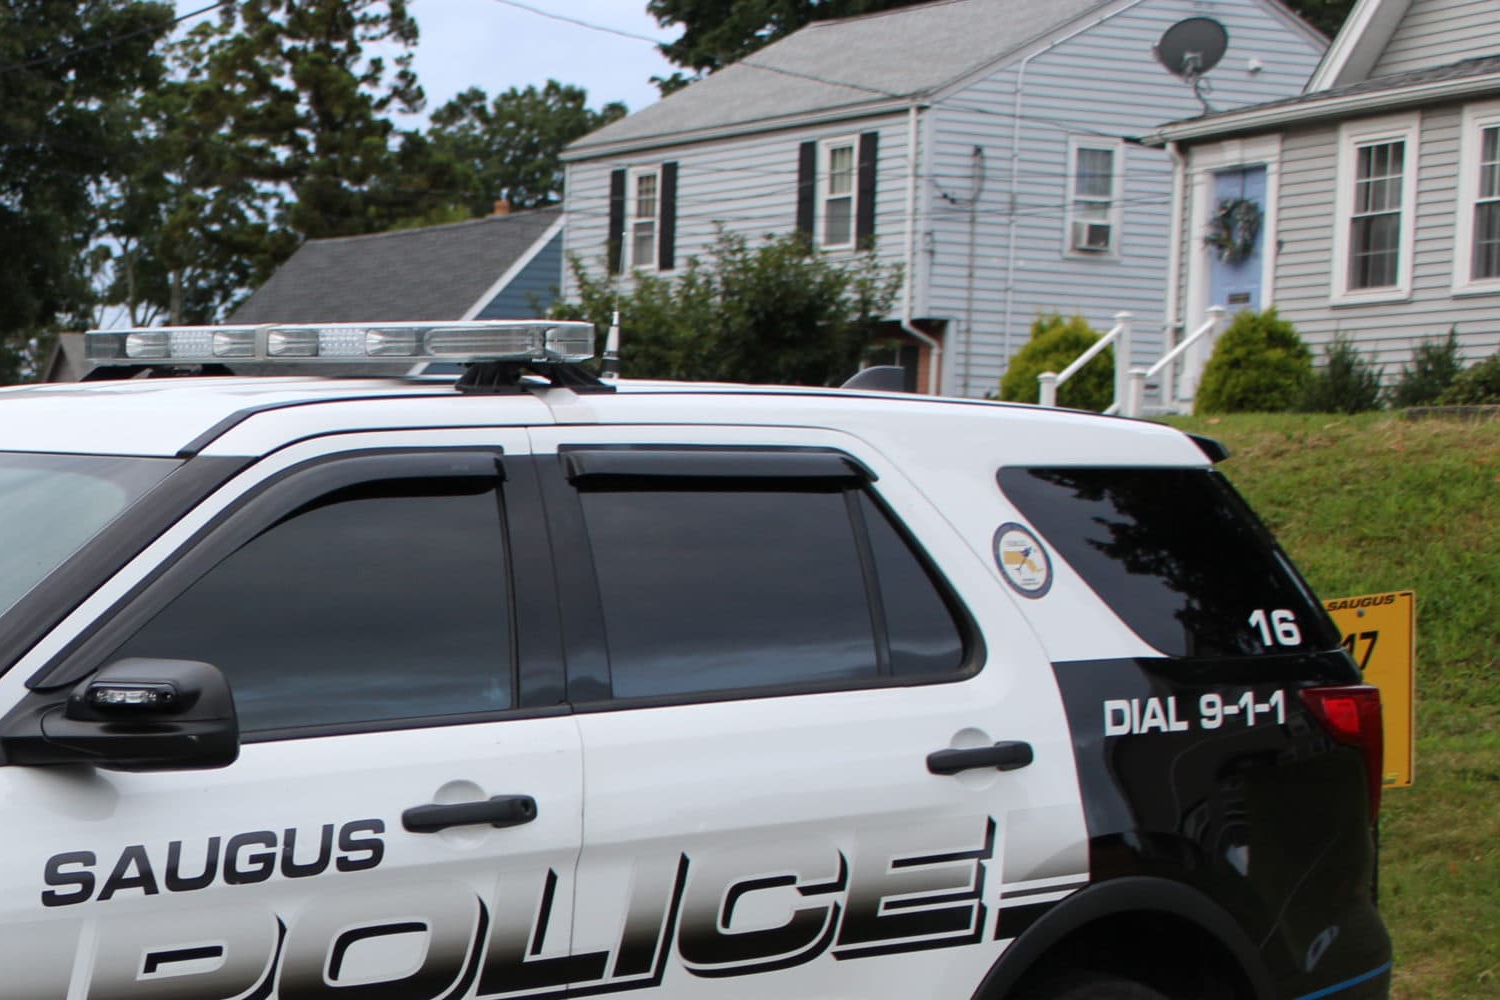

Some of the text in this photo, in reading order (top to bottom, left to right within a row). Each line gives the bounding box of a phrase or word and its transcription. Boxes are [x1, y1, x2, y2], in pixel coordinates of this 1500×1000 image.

[1328, 594, 1396, 612] SAUGUS
[1248, 609, 1301, 647] 16
[1104, 689, 1285, 737] DIAL 9-1-1
[41, 818, 386, 907] SAUGUS
